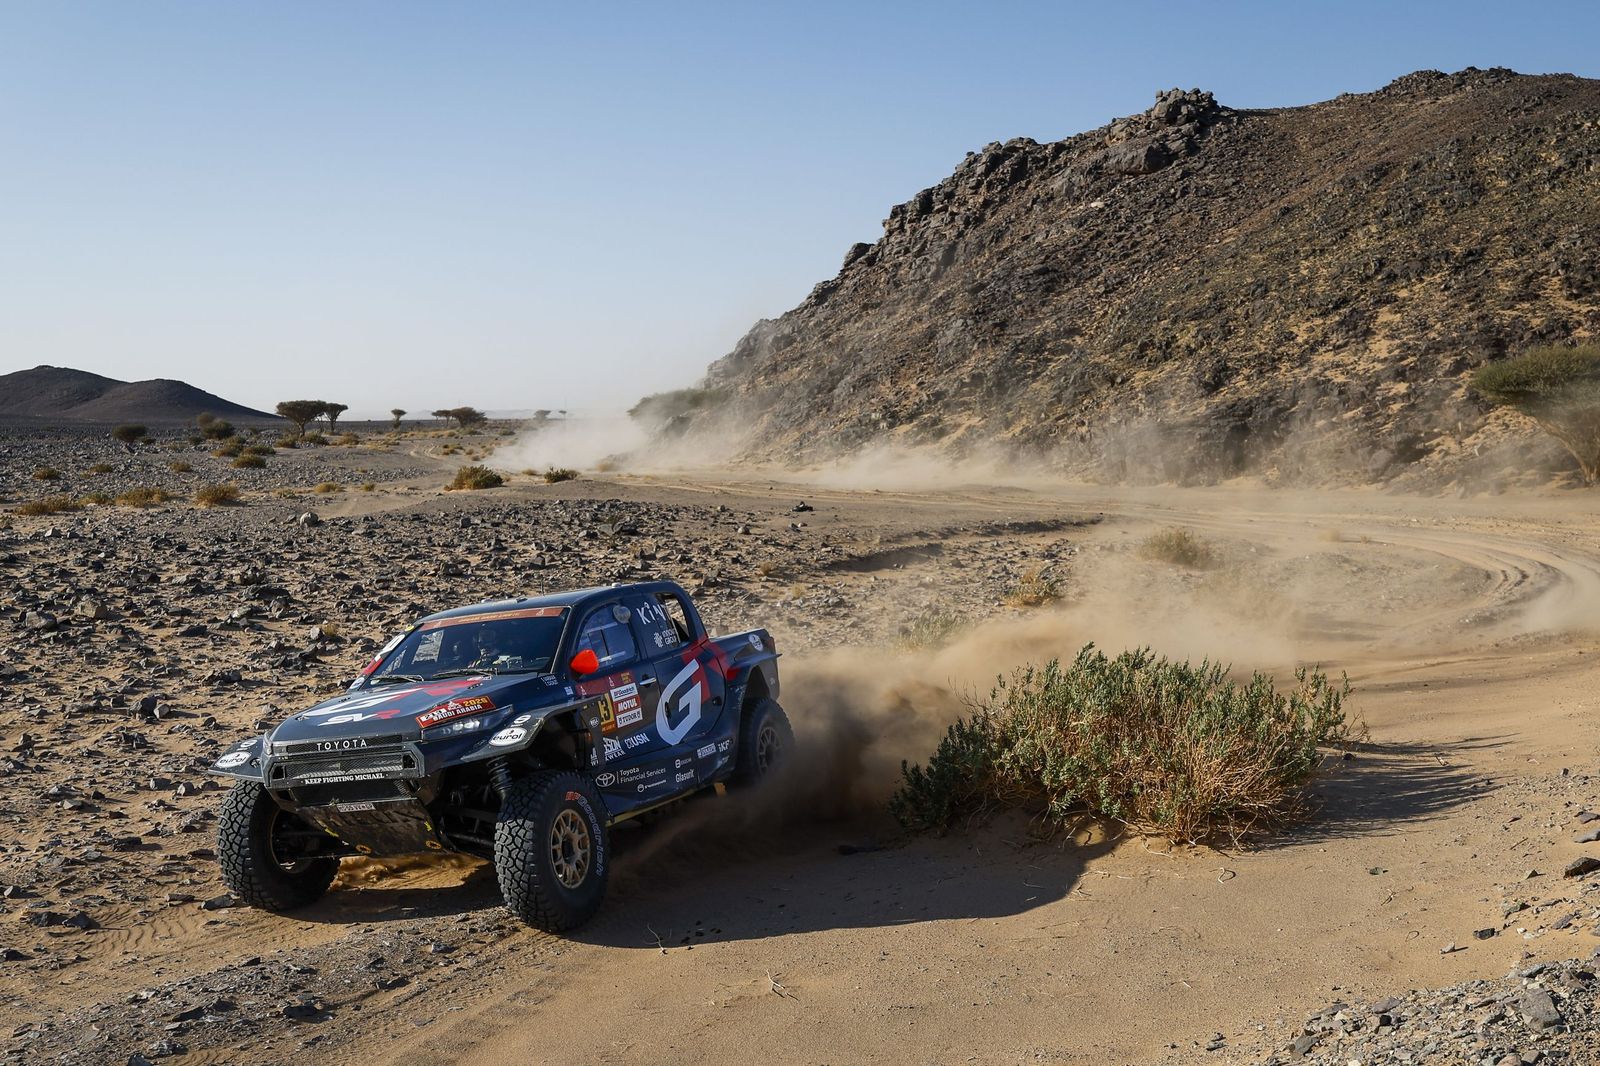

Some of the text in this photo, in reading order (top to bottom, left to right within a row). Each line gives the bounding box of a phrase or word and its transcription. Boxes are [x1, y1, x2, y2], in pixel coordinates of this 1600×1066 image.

[617, 698, 638, 712] MOTUL
[433, 711, 456, 721] SAUDI
[456, 704, 483, 715] ARABIA
[492, 732, 523, 741] eurol
[630, 732, 650, 747] USN
[316, 739, 367, 752] TOYOTA
[219, 755, 247, 764] eurol
[304, 772, 385, 785] KEEP FIGHTING MICHAEL
[620, 767, 640, 777] Toyota
[620, 768, 667, 784] Financial Services
[565, 791, 604, 876] BFGoodrich
